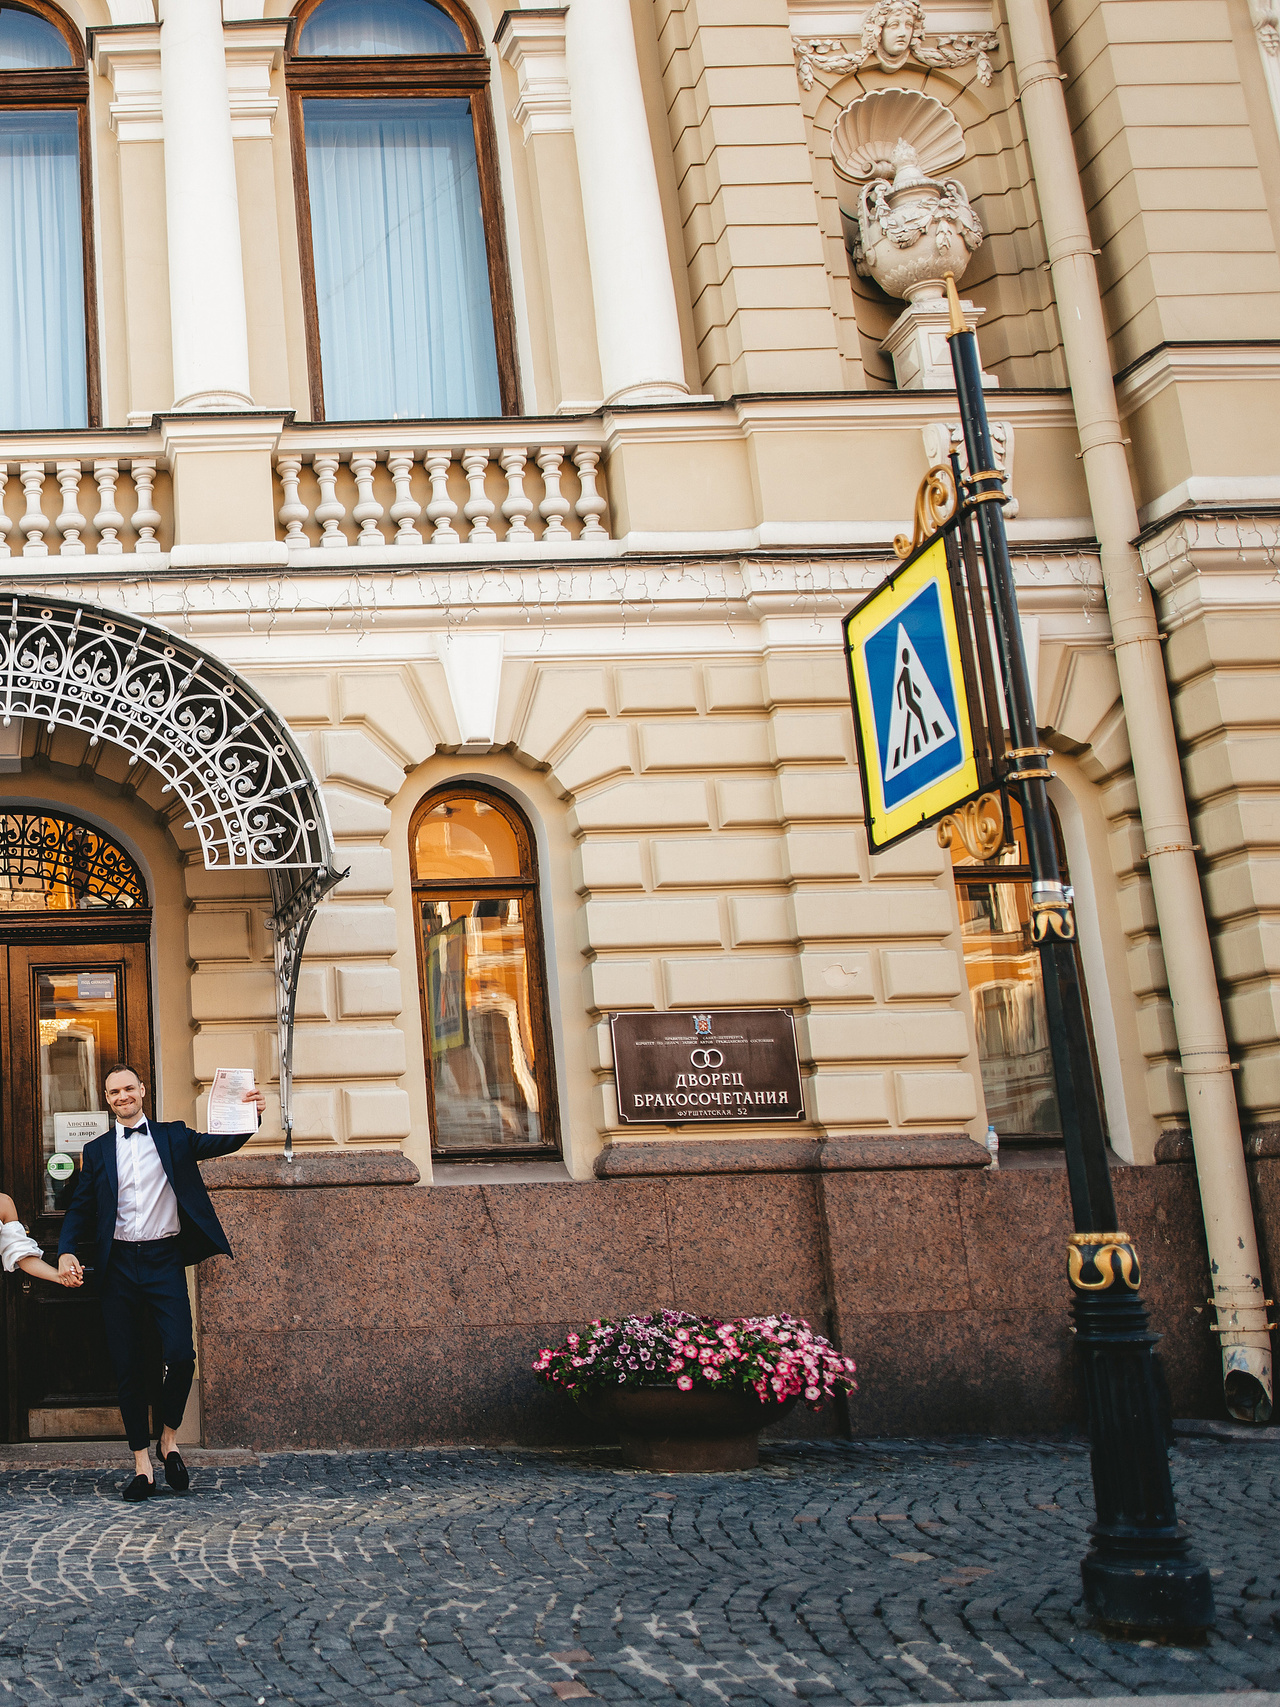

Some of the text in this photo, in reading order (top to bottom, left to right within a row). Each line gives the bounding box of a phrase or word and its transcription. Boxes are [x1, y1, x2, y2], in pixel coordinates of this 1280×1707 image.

[675, 1072, 745, 1089] ДВОРЕЦ
[633, 1090, 789, 1107] БРАКОСОЧЕТАНИЯ
[737, 1108, 748, 1116] 52
